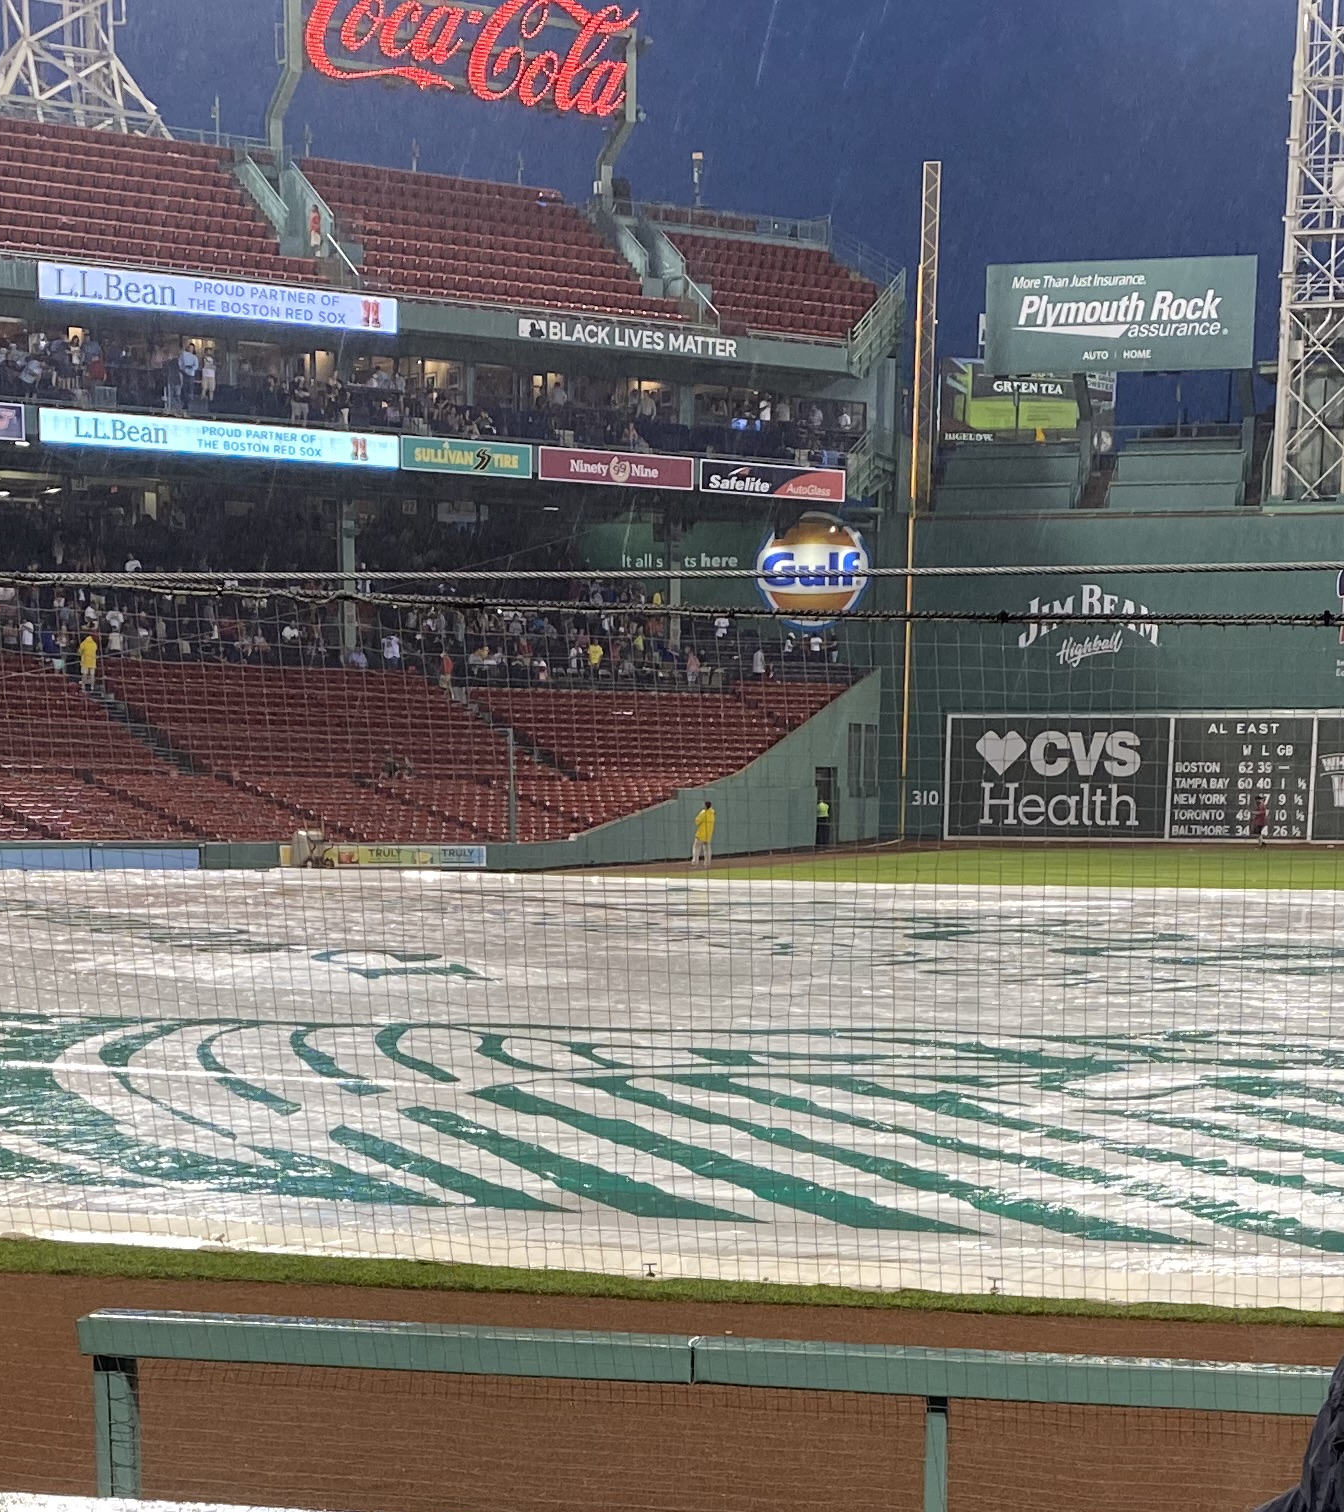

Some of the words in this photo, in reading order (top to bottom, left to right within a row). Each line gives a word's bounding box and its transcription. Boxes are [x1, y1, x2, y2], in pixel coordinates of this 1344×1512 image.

[304, 0, 640, 117] Coca-Cola
[54, 268, 177, 307] L.L.Bean
[194, 281, 245, 298] PROUD
[250, 286, 315, 306] PARTNER
[321, 294, 340, 307] OF
[1012, 275, 1041, 290] More
[1043, 275, 1068, 289] Than
[1070, 274, 1092, 288] Just
[188, 297, 216, 312] THE
[221, 301, 280, 319] BOSTON
[285, 308, 313, 322] RED
[318, 311, 346, 325] SOX
[1017, 291, 1146, 329] Plymouth
[1150, 289, 1222, 321] Rock
[548, 322, 610, 345] BLACK
[615, 328, 665, 352] LIVES
[668, 331, 738, 358] MATTER
[1082, 350, 1109, 361] AUTO
[1123, 349, 1152, 360] HOME
[993, 380, 1038, 394] GREEN
[1040, 384, 1064, 395] TEA
[73, 416, 168, 445] L.L.Bean
[201, 425, 242, 438] PROUD
[245, 428, 297, 442] PARTNER
[301, 432, 317, 443] OF
[198, 438, 221, 450] THE
[223, 440, 270, 454] BOSTON
[273, 443, 296, 455] RED
[300, 445, 322, 458] SOX
[414, 447, 473, 466] SULLIVAN
[493, 454, 519, 469] TIRE
[570, 459, 608, 477] Ninety
[631, 464, 659, 479] Nine
[709, 472, 771, 494] Safelite
[786, 482, 832, 498] AutoGlass
[621, 554, 632, 568] It
[634, 553, 652, 568] all
[655, 555, 697, 568] sts
[700, 552, 739, 568] here
[762, 551, 862, 588] Gulf
[1018, 594, 1076, 649] JIM
[1080, 583, 1161, 647] BEAM
[1056, 630, 1123, 669] Highball
[1208, 723, 1228, 734] AL
[1236, 723, 1280, 735] EAST
[1029, 730, 1142, 778] CVS
[1242, 744, 1252, 756] W
[1261, 744, 1270, 756] L
[1277, 744, 1294, 757] GB
[1174, 762, 1221, 774] BOSTON
[1238, 762, 1254, 774] 62
[1174, 777, 1208, 789] TAMPA
[1209, 777, 1230, 789] BAY
[911, 790, 939, 806] 310
[978, 782, 1140, 827] Health
[1173, 793, 1196, 805] NEW
[1198, 793, 1228, 806] YORK
[1173, 809, 1225, 821] TORONTO
[1171, 825, 1230, 837] BALTIMORE
[367, 848, 402, 858] TRULY
[441, 848, 474, 858] TRULY
